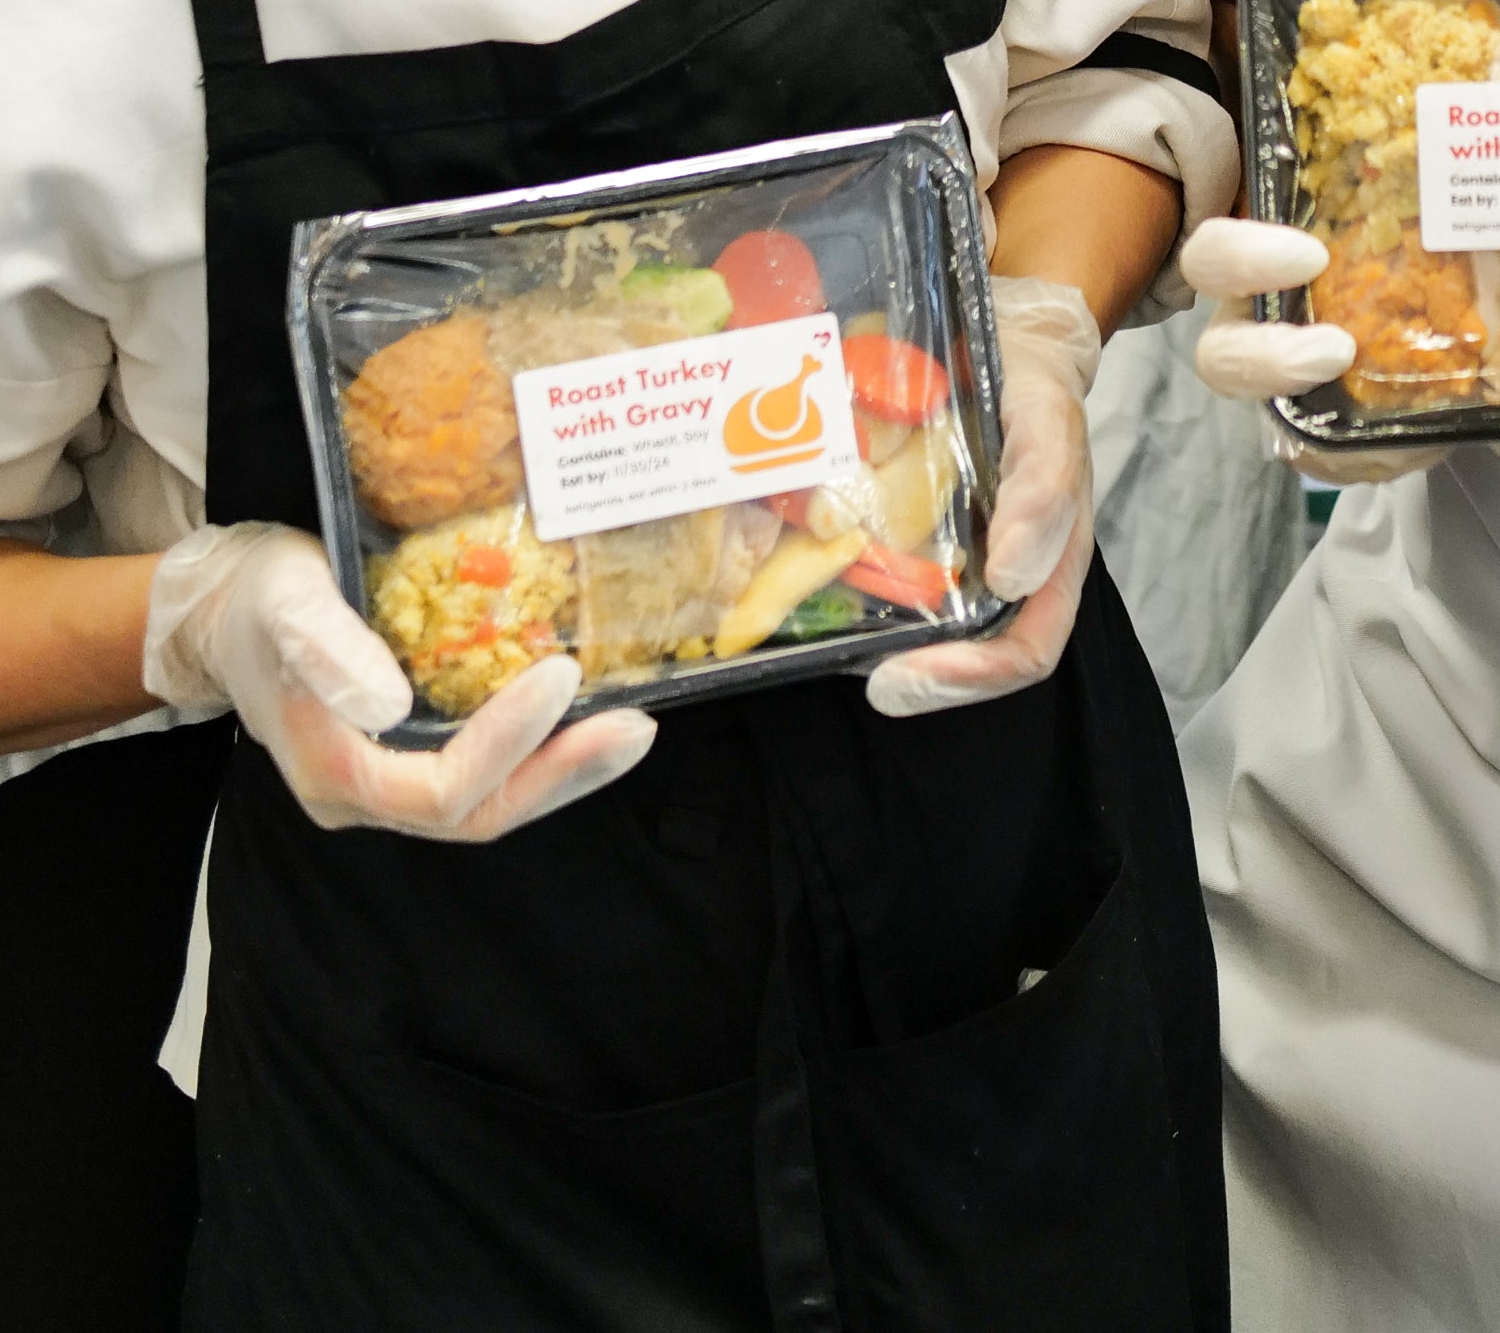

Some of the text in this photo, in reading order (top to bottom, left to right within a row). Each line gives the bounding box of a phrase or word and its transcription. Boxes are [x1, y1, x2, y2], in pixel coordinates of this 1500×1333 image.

[1451, 195, 1473, 206] Eat
[547, 358, 733, 409] Roast Turkey
[553, 396, 713, 441] with Gravy
[683, 429, 710, 444] Soy
[560, 474, 584, 489] Eat
